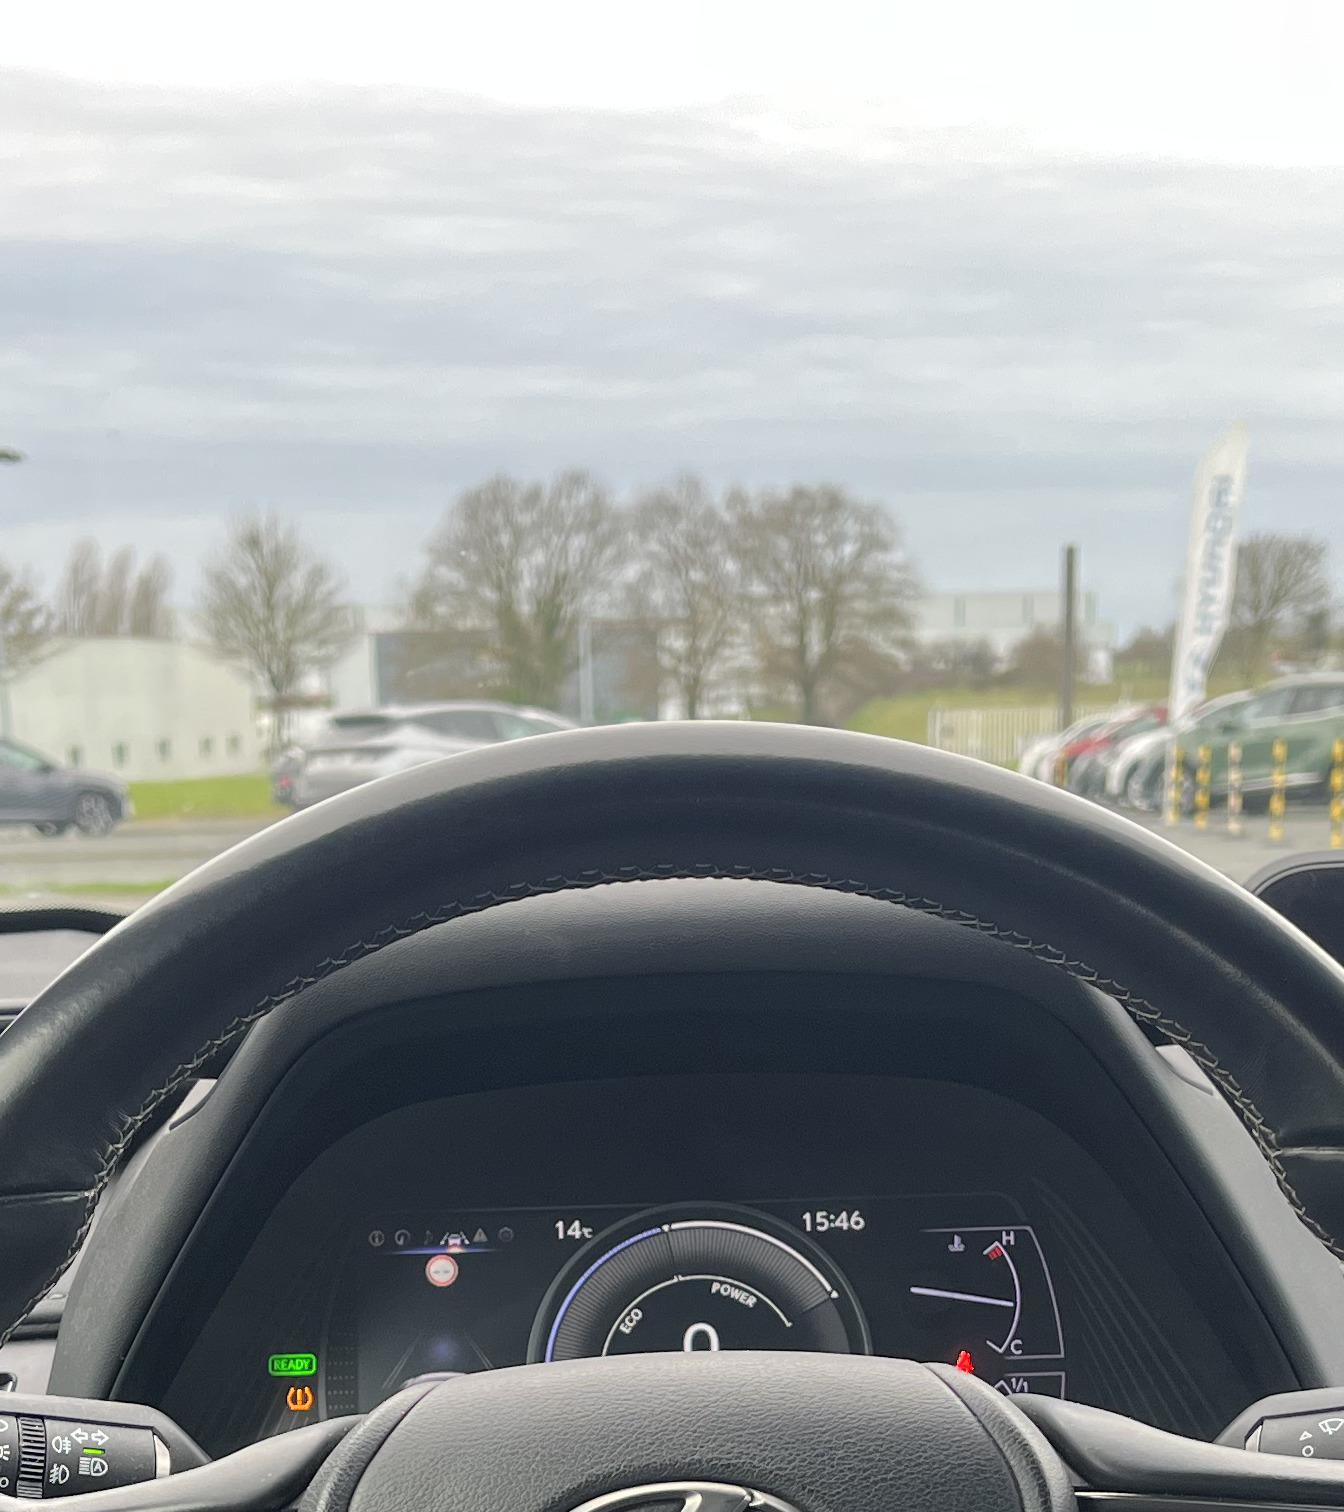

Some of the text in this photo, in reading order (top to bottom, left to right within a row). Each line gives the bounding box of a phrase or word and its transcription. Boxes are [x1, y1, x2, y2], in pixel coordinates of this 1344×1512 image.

[802, 1210, 866, 1232] 15:46
[1002, 1231, 1015, 1246] H
[711, 1280, 757, 1309] POWER
[619, 1308, 644, 1335] ECO
[1010, 1339, 1023, 1355] C
[273, 1358, 311, 1371] READY
